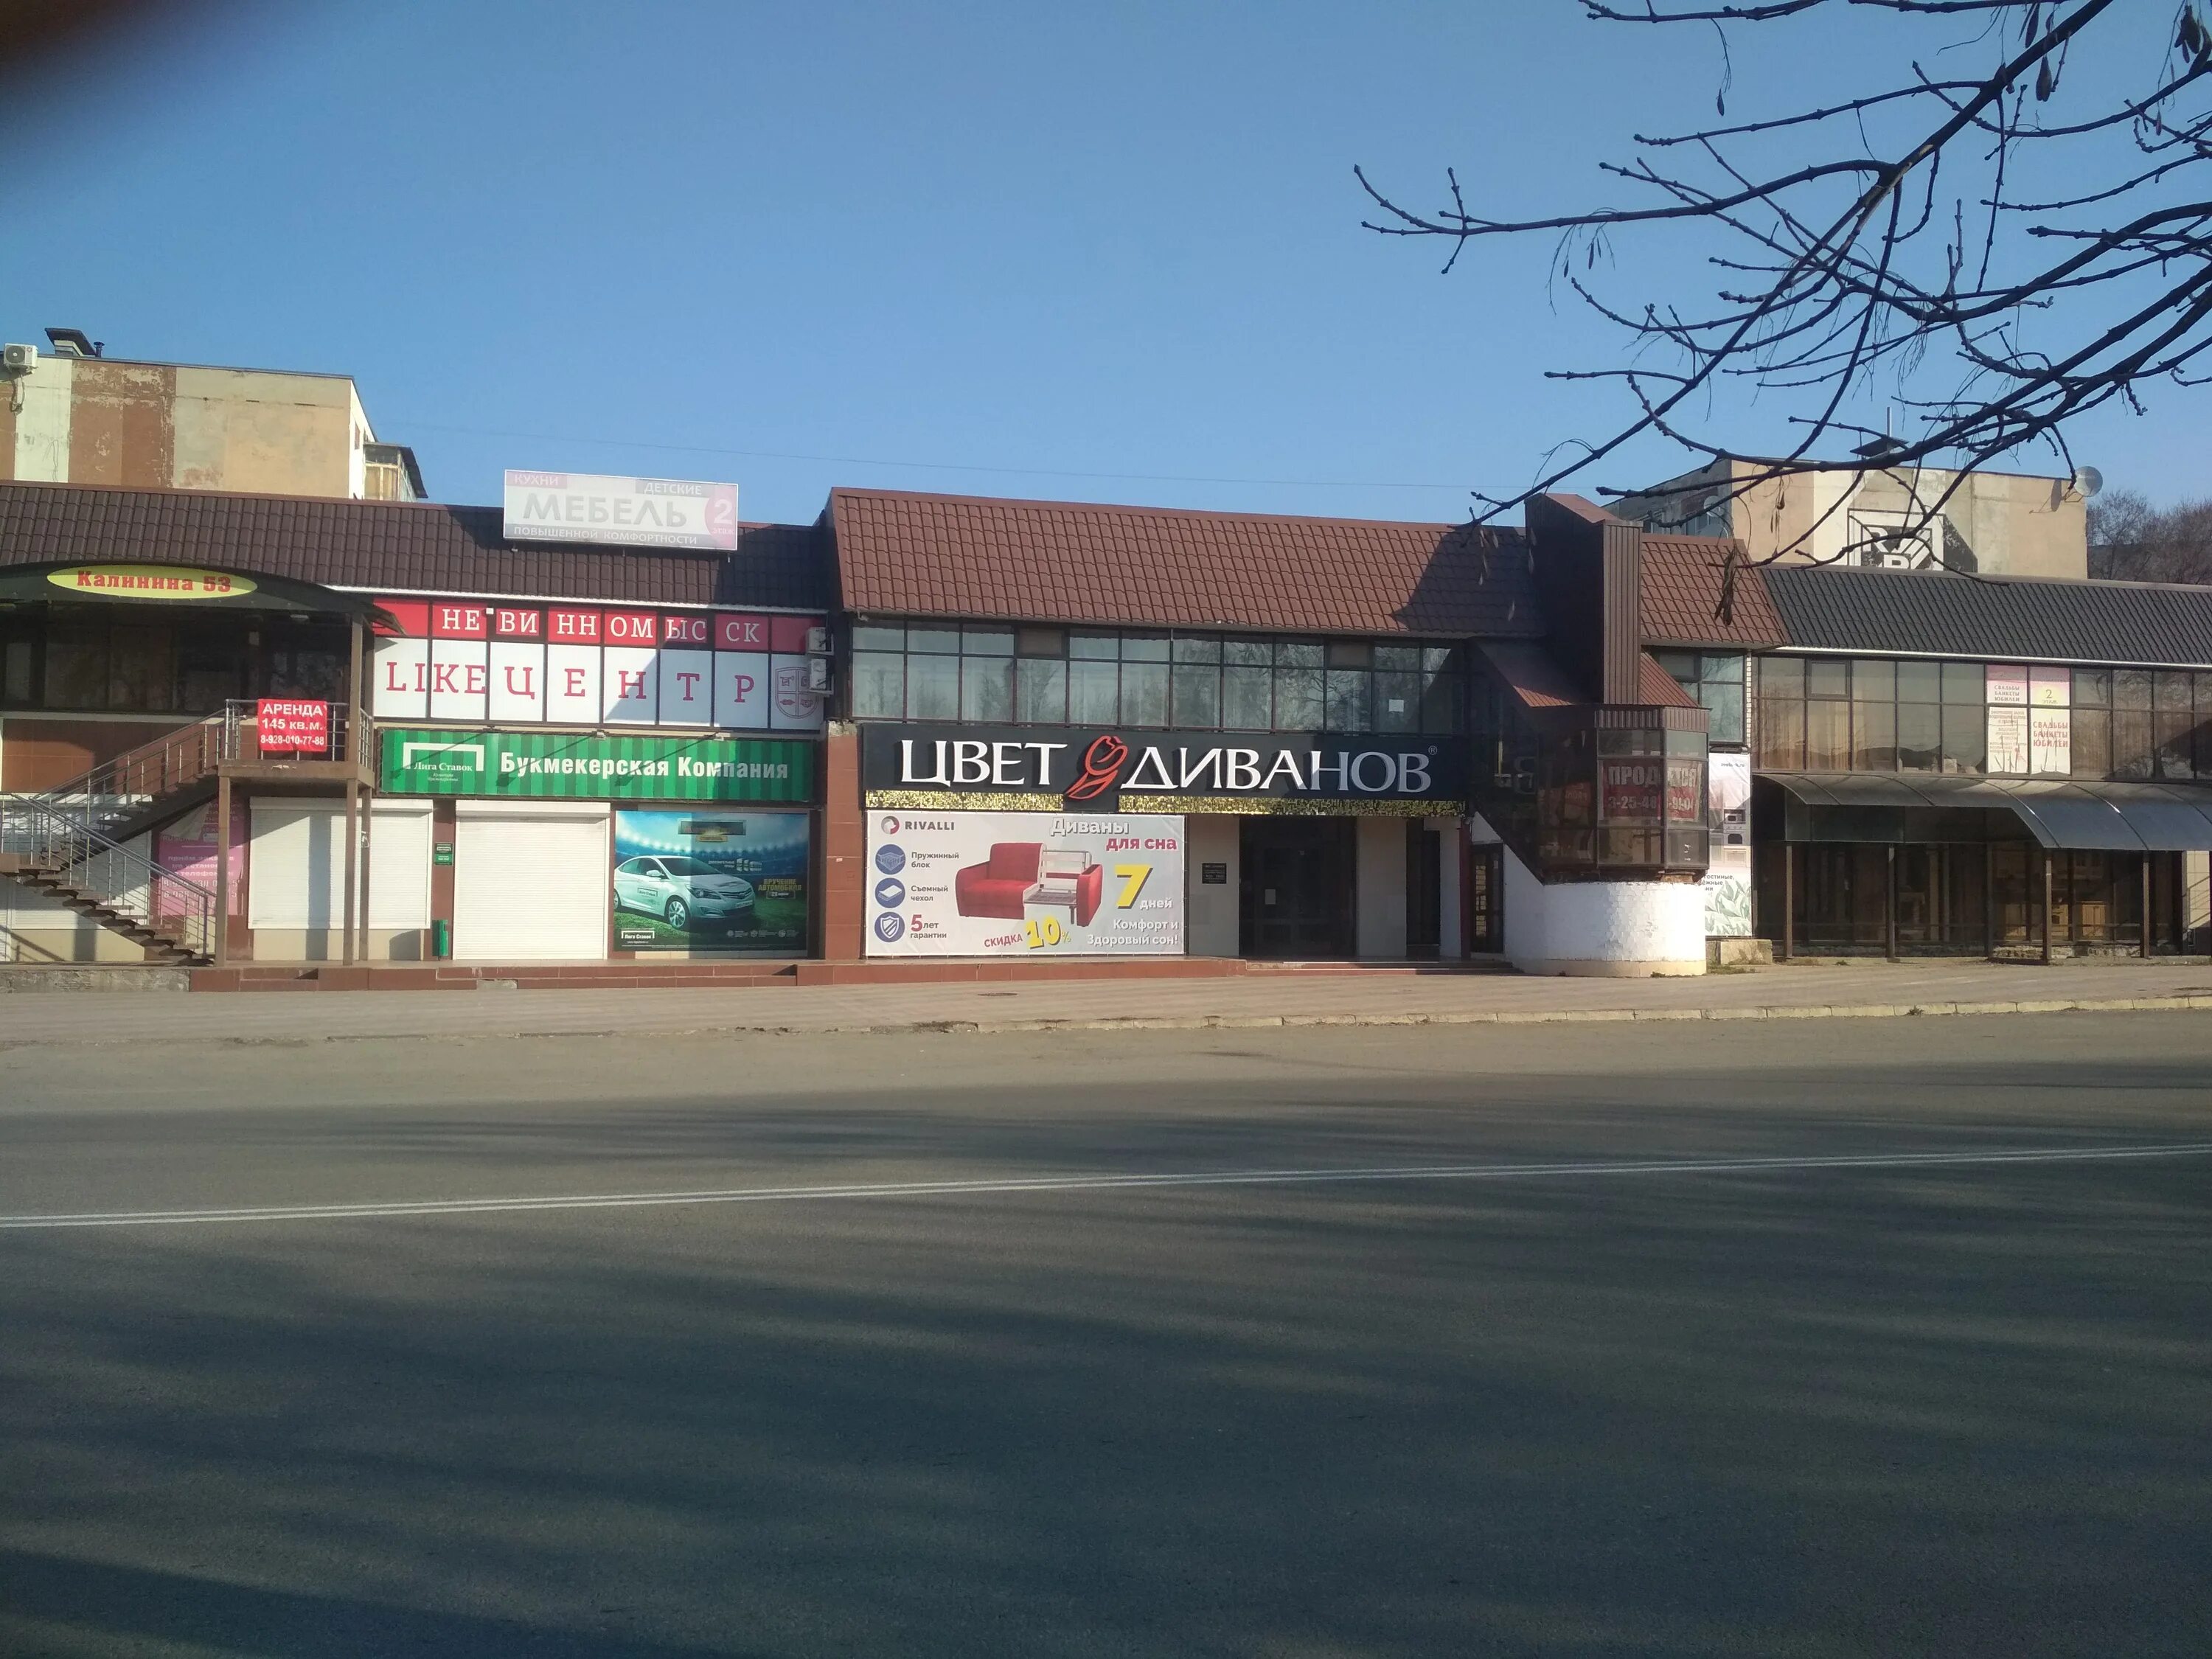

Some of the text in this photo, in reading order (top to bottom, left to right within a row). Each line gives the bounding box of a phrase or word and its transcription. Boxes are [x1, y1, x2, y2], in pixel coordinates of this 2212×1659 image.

[514, 474, 559, 487] КУХНИ
[644, 481, 702, 495] ДЕТСКИЕ
[523, 493, 687, 528] МЕБЕЛЬ
[713, 499, 734, 526] 2
[514, 525, 698, 545] ПОВЫШЕННОЙ КОМФОРТНОСТИ
[77, 571, 231, 592] Калинина 53
[2045, 689, 2053, 699] 2
[262, 703, 324, 717] АРЕНДА
[262, 718, 286, 729] 145
[2033, 720, 2068, 729] СВАДЬБЫ
[260, 734, 324, 746] 8-928-010-77-88
[2033, 730, 2068, 738] БАНКЕТЫ
[414, 762, 473, 772] Лига Ставок
[501, 751, 788, 779] Букмекерская Компания
[901, 740, 1068, 787] ЦВЕТ
[1608, 765, 1696, 788] ПРОДЕТСЯ
[904, 820, 955, 830] RIVALLI
[1050, 817, 1130, 836] Диваны
[1106, 838, 1178, 851] для сна
[911, 852, 959, 860] Пружинный
[1114, 864, 1154, 909] 7
[1139, 897, 1173, 911] дней
[1113, 919, 1180, 932] Комфорт и
[984, 933, 1023, 947] СКИДКА
[1088, 933, 1179, 947] Здоровый сон!
